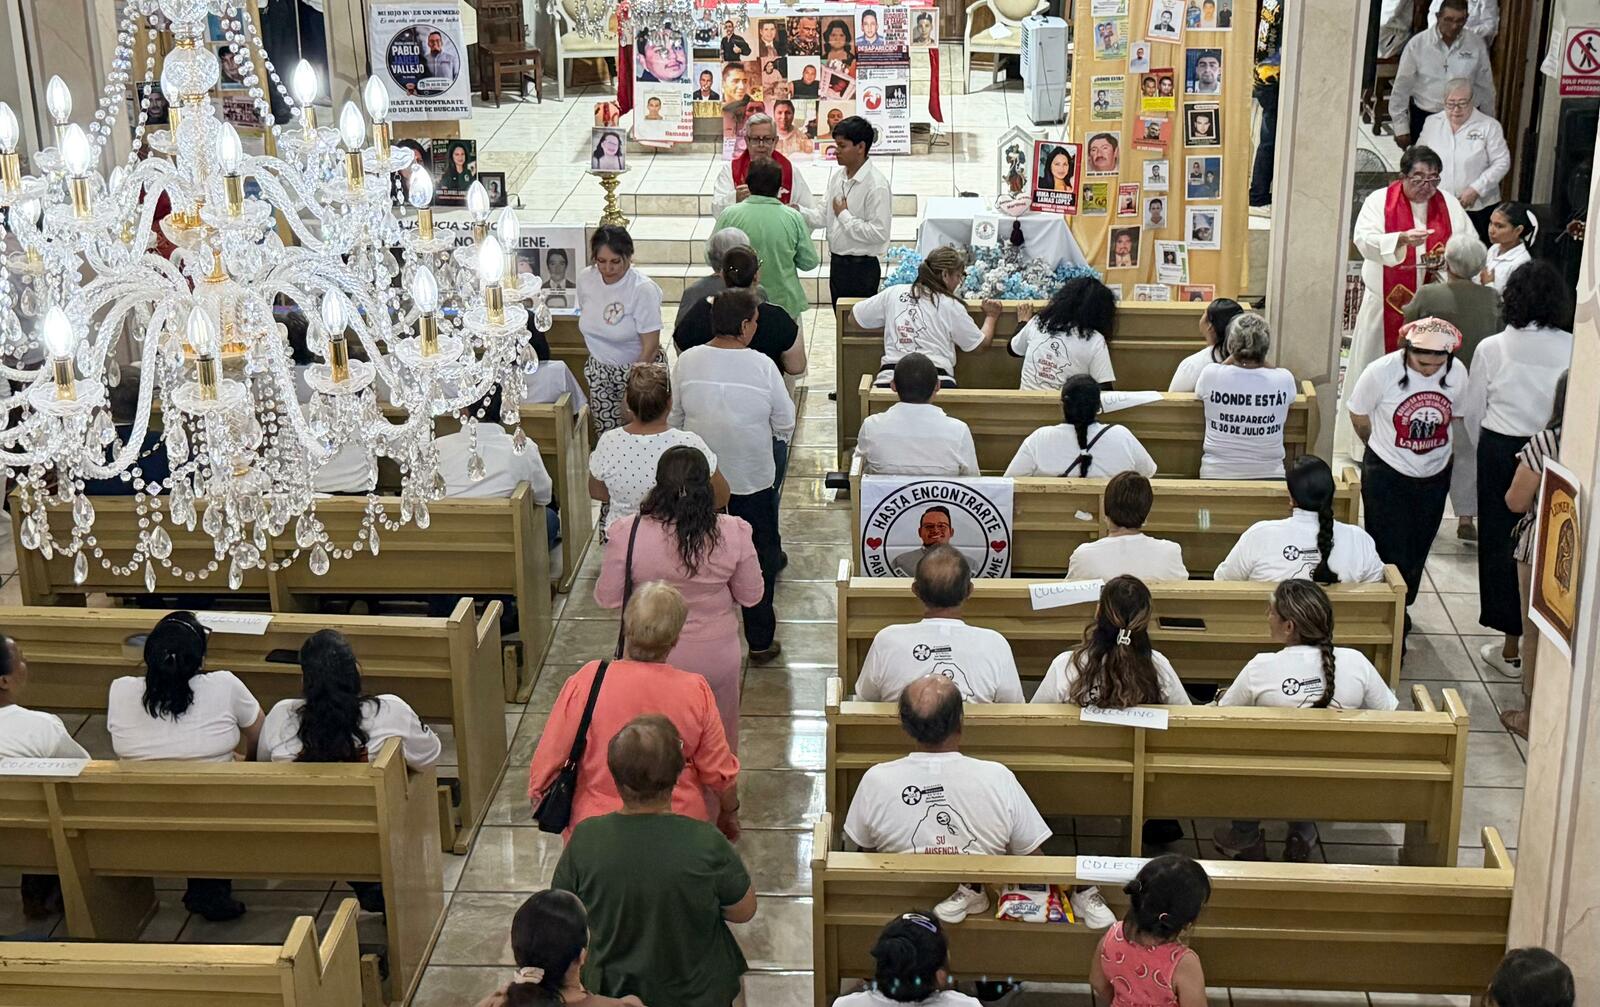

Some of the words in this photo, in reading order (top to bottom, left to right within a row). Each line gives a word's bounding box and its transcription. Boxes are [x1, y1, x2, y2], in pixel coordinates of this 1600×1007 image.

[391, 45, 420, 56] PABLO
[391, 64, 425, 74] VALLEJO
[1210, 390, 1252, 406] ¿DONDE
[1255, 390, 1287, 407] ESTÁ?
[1219, 412, 1276, 425] DESAPARECIÓ
[1211, 420, 1218, 430] EL
[1219, 423, 1229, 433] 30
[1230, 425, 1241, 435] DE
[1242, 426, 1265, 436] JULIO
[872, 494, 911, 531] HASTA
[911, 485, 1002, 534] ENCONTRARTE
[936, 835, 946, 845] SU
[924, 845, 960, 855] AUSENCIA
